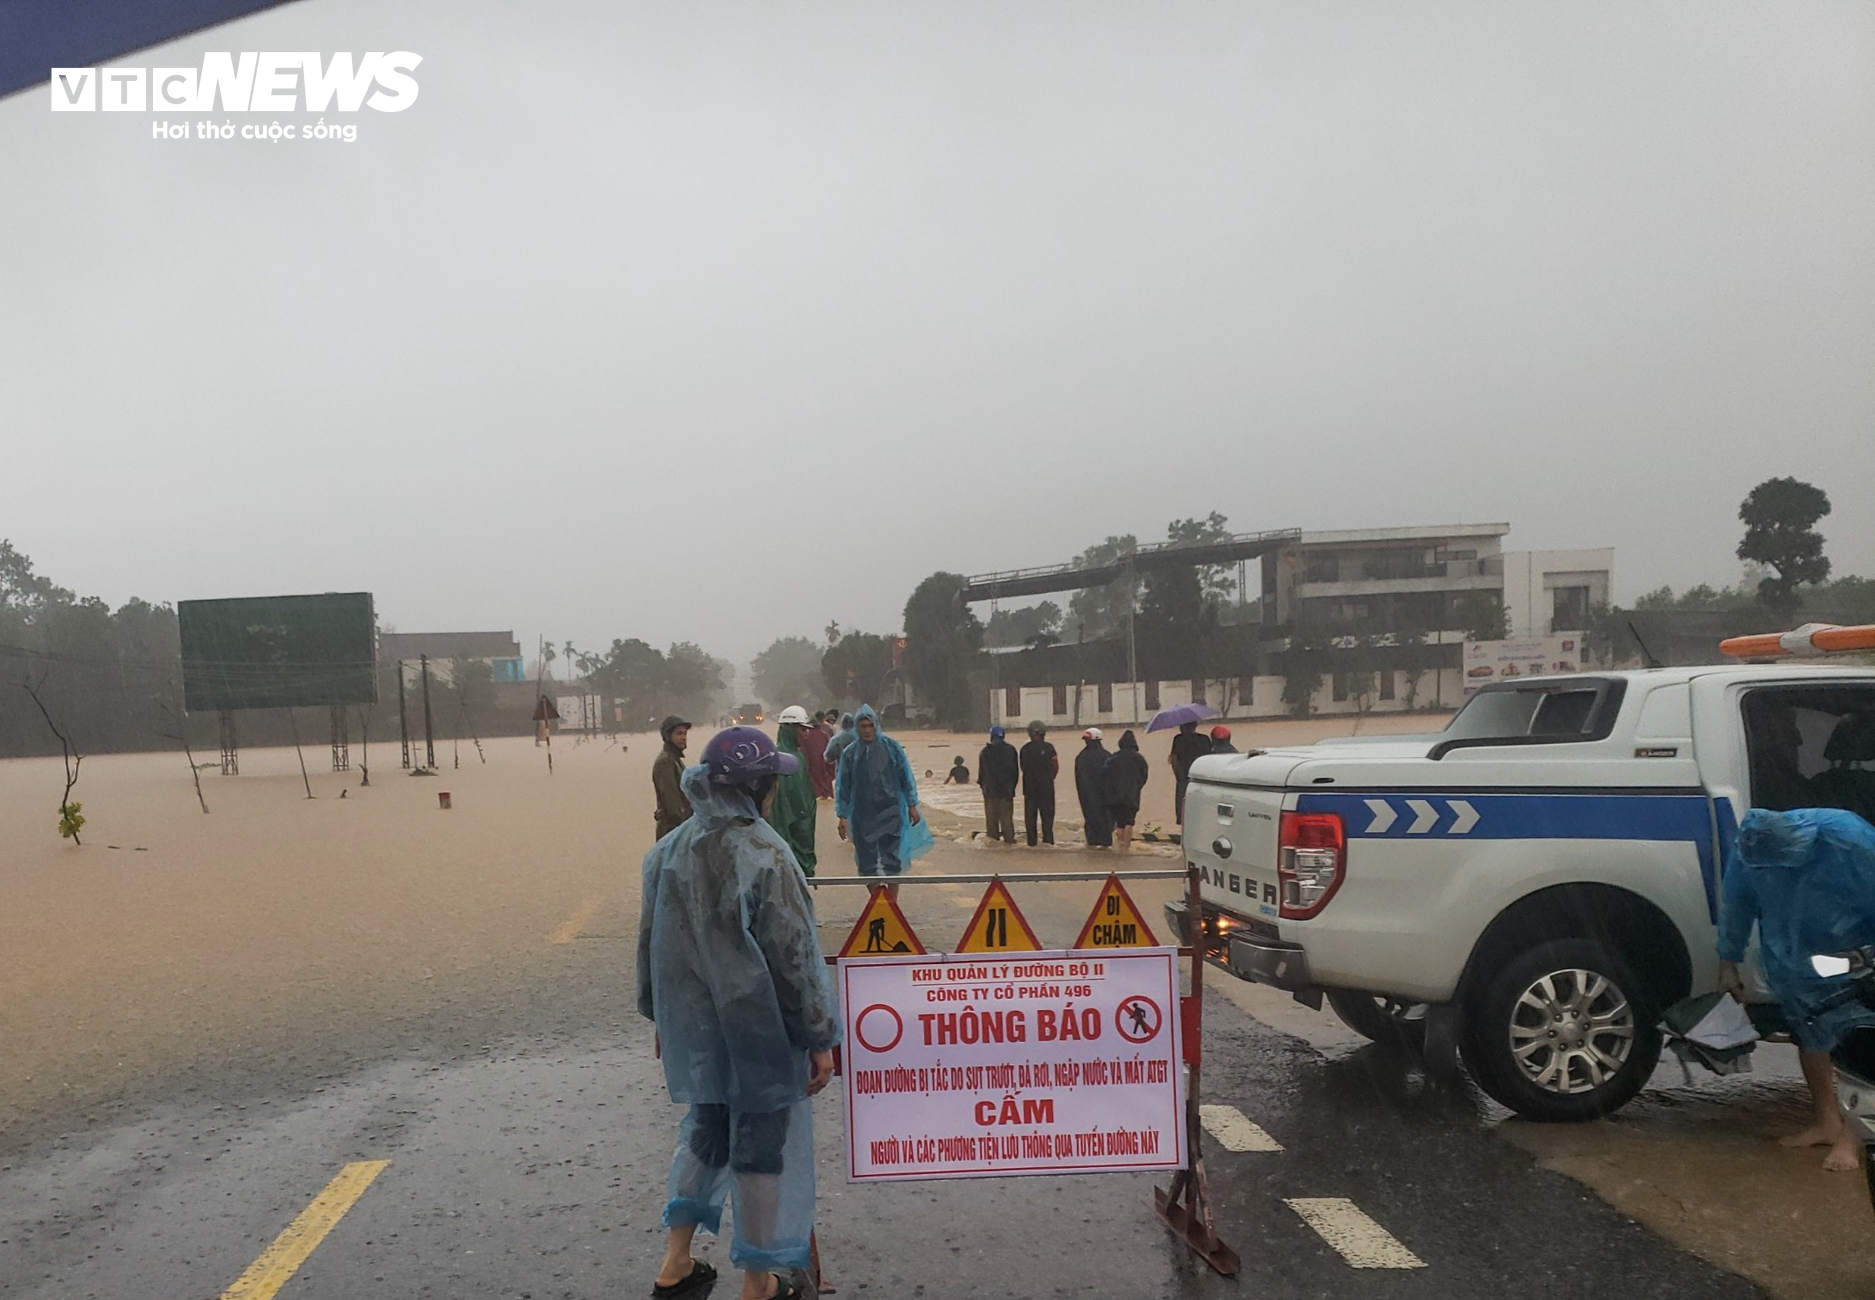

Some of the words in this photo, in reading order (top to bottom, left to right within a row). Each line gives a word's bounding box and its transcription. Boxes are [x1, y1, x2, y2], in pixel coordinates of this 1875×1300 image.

[1106, 895, 1120, 916] ĐI
[1093, 919, 1136, 948] CHẬM
[912, 969, 942, 981] KHU
[947, 964, 988, 981] QUẢN
[992, 964, 1009, 978] LÝ
[1013, 963, 1064, 978] ĐƯỜNG
[1069, 962, 1089, 978] BỘ
[1093, 963, 1104, 976] II
[927, 987, 968, 1002] CÔNG
[972, 988, 989, 1000] TY
[994, 982, 1014, 1000] CỔ
[1018, 983, 1060, 999] PHẦN
[1064, 985, 1092, 997] 496
[918, 1005, 1026, 1046] THÔNG
[1037, 1001, 1102, 1042] BÁO
[856, 1070, 883, 1099] ĐOẠN
[884, 1063, 917, 1093] ĐƯỜNG
[919, 1068, 929, 1097] BỊ
[931, 1059, 949, 1092] TẮC
[951, 1066, 964, 1091] DO
[965, 1066, 984, 1095] SỤT
[986, 1063, 1017, 1094] TRƯỢT,
[1018, 1059, 1031, 1087] ĐÁ
[1034, 1062, 1053, 1090] RƠI,
[1054, 1058, 1080, 1091] NGẬP
[1082, 1057, 1108, 1086] NƯỚC
[1110, 1057, 1122, 1084] VÀ
[1124, 1052, 1145, 1084] MẤT
[1147, 1060, 1169, 1083] ATGT
[975, 1091, 1055, 1126] CẤM
[870, 1135, 900, 1165] NGƯỜI
[902, 1135, 915, 1163] VÀ
[916, 1134, 936, 1163] CÁC
[938, 1136, 976, 1161] PHƯƠNG
[978, 1132, 999, 1165] TIỆN
[1001, 1135, 1019, 1159] LƯU
[1021, 1130, 1053, 1158] THÔNG
[1054, 1134, 1073, 1160] QUA
[1075, 1125, 1105, 1157] TUYẾN
[1107, 1126, 1139, 1155] ĐƯỜNG
[1140, 1126, 1160, 1154] NÀY
